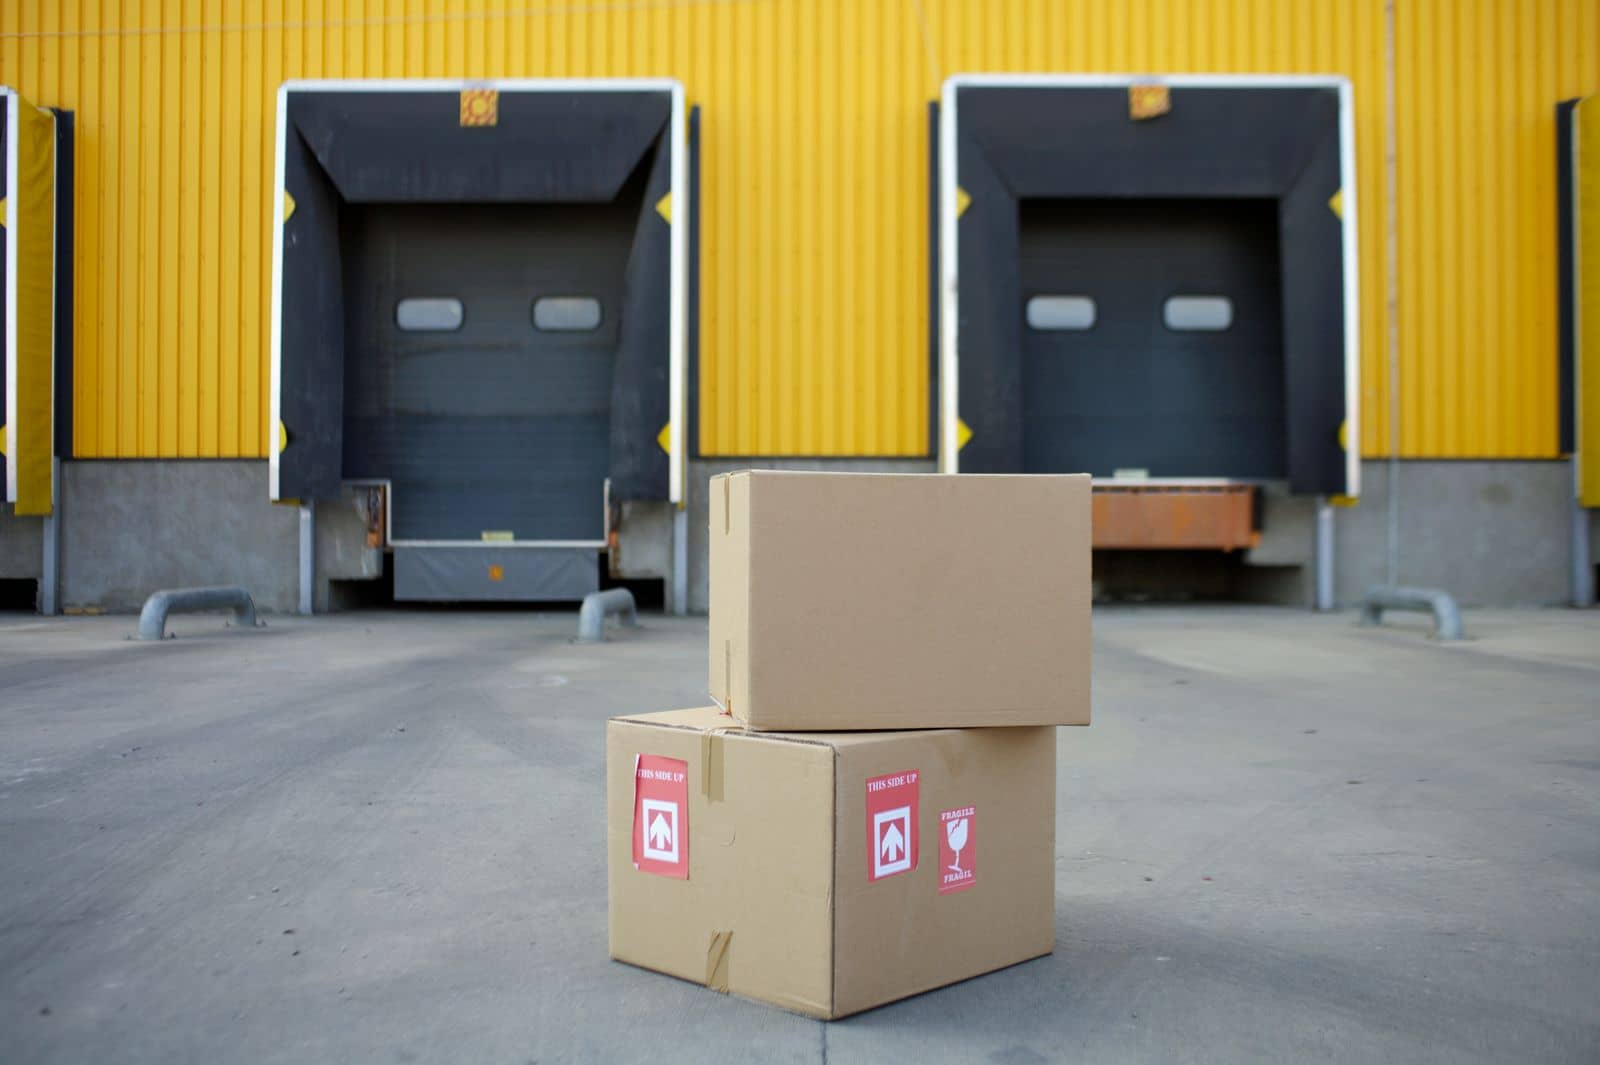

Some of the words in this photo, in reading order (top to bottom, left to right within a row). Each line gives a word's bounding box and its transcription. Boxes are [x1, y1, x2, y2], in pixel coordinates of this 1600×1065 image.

[655, 770, 672, 781] SIDE
[674, 773, 684, 783] UP
[867, 780, 886, 792] THIS
[887, 775, 905, 788] SIDE
[906, 773, 917, 783] UP
[941, 807, 975, 820] FRAGILE
[944, 870, 972, 883] FRAGIL
